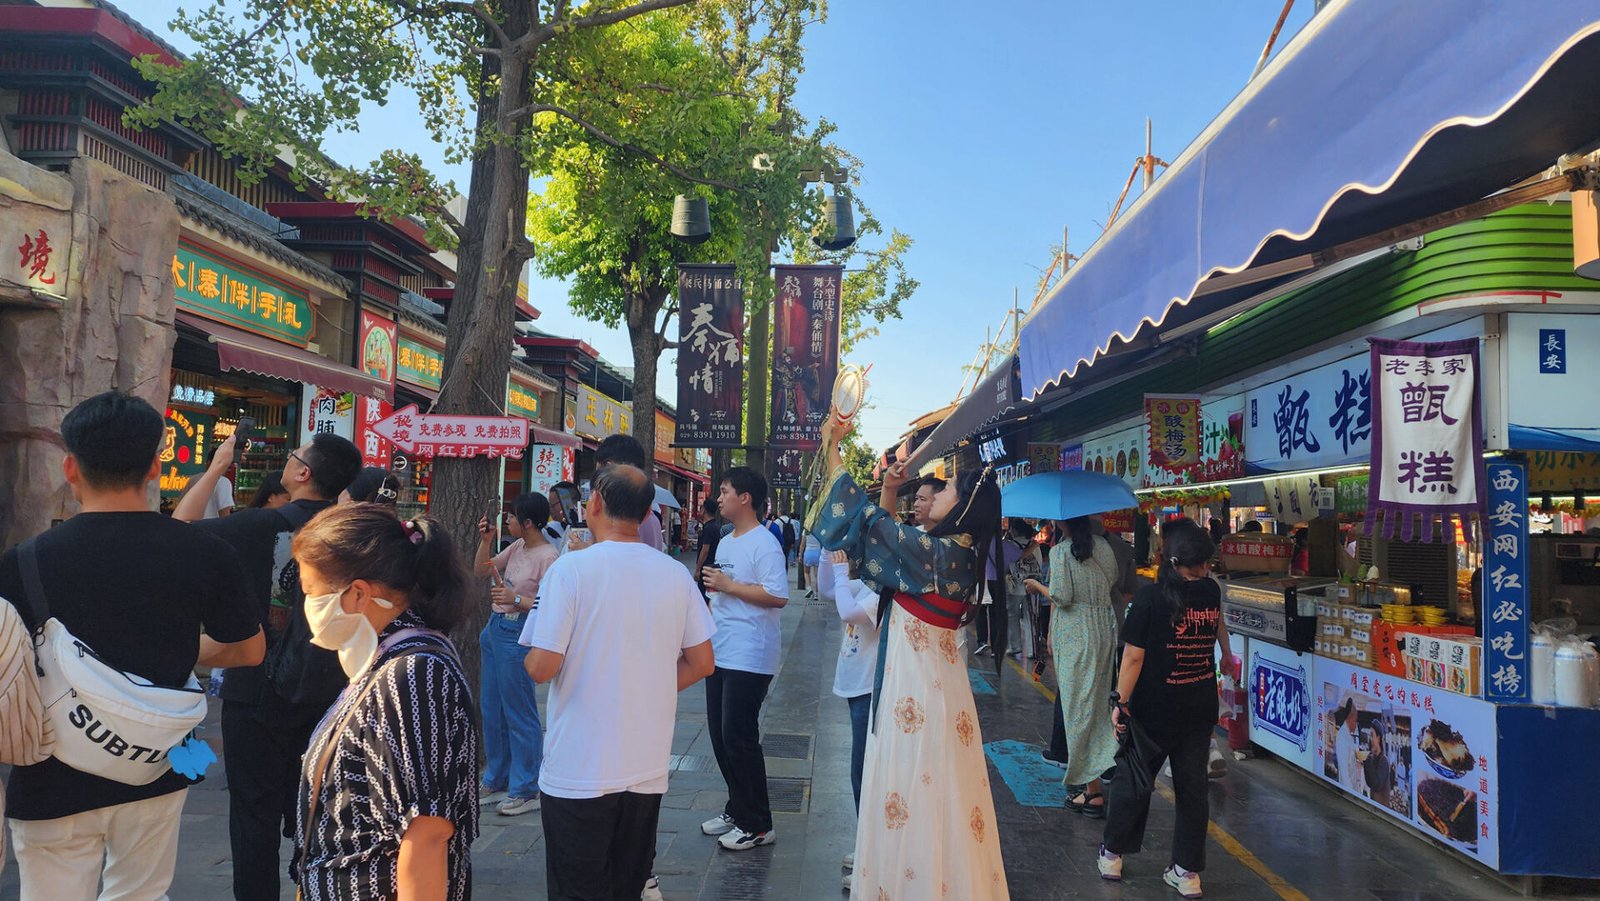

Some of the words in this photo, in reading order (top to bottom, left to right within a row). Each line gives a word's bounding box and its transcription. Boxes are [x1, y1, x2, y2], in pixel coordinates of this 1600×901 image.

[19, 229, 55, 284] 境
[824, 276, 836, 322] 大型史诗
[1386, 358, 1466, 376] 老李家
[1543, 333, 1562, 369] 長安
[364, 398, 382, 467] 陕西
[392, 414, 413, 443] 秘境
[419, 423, 467, 438] 免费参观
[474, 425, 521, 440] 免费拍照
[693, 431, 713, 439] 8391
[716, 431, 736, 439] 1910
[789, 433, 809, 441] 8391
[1164, 415, 1187, 457] 酸梅汤
[1398, 381, 1458, 494] 甑糕
[417, 443, 525, 459] 网红打卡地
[1488, 469, 1524, 695] 西安网红必吃榜
